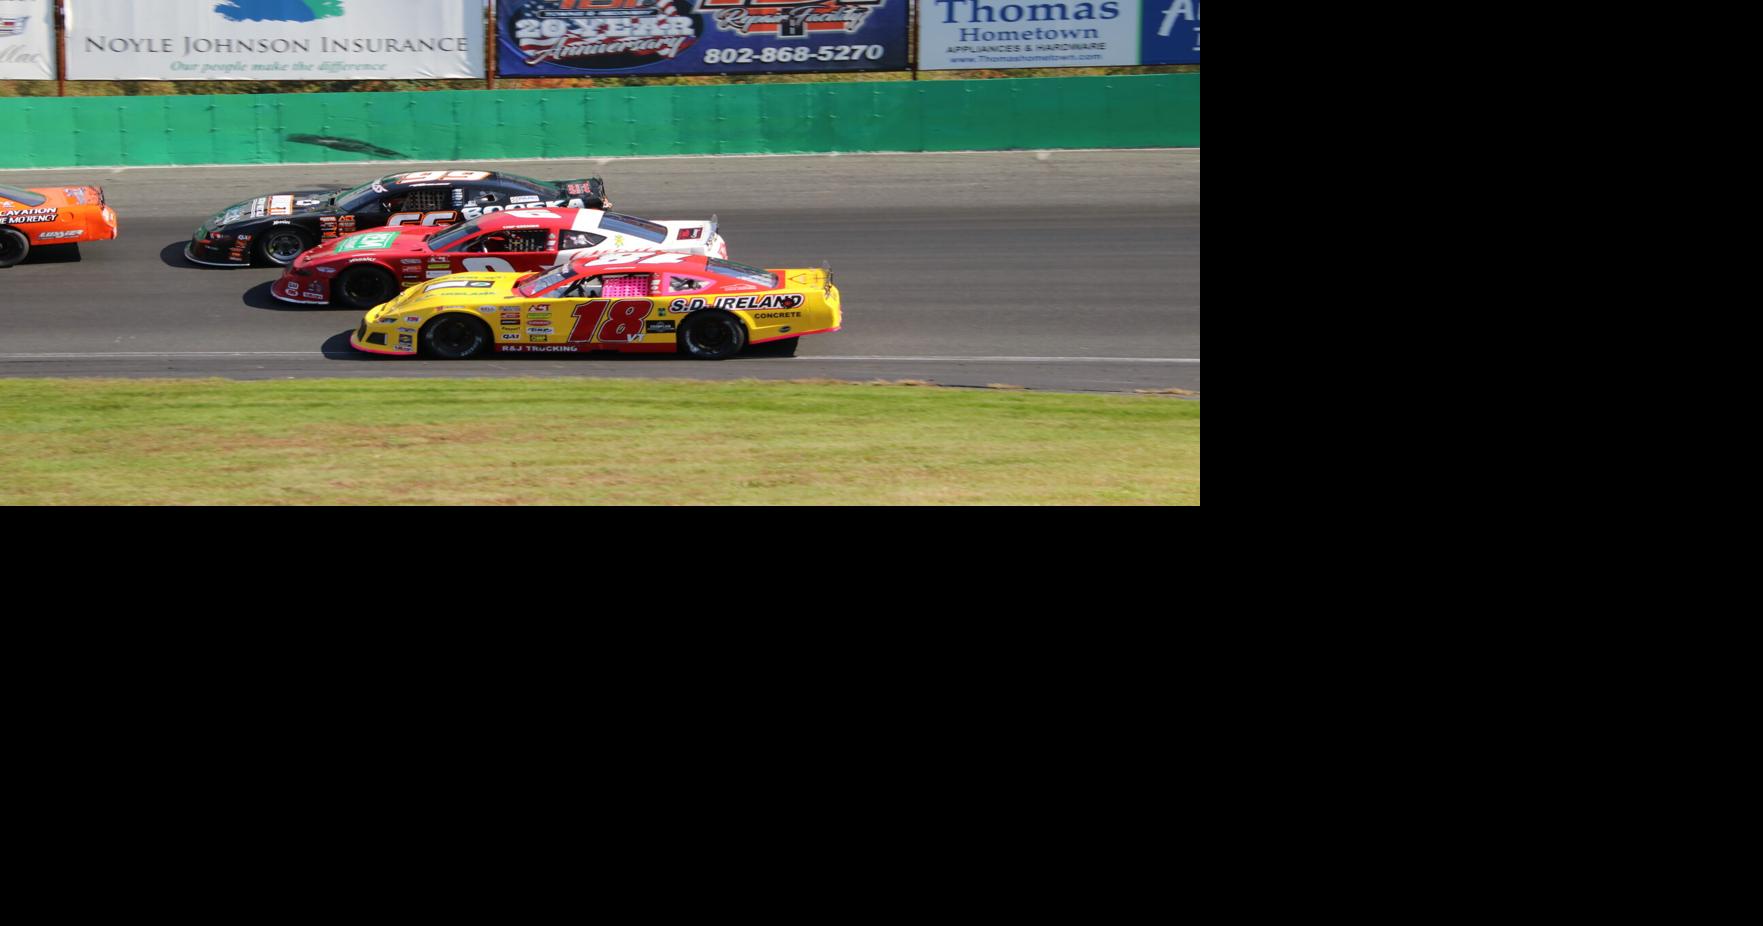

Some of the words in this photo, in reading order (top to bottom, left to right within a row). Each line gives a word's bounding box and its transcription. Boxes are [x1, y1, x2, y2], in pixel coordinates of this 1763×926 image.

[934, 0, 1120, 23] Thomas
[515, 19, 568, 38] 20
[571, 16, 695, 37] YEAR
[958, 27, 1099, 42] Hometown
[84, 36, 173, 53] NOYLE
[183, 36, 310, 55] JOHNSON
[319, 36, 468, 53] INSURANCE
[525, 36, 685, 65] Anniversary
[946, 45, 1020, 53] APPLIANCES
[1036, 42, 1106, 51] HARDWARE
[703, 45, 885, 64] 802-868-5270
[170, 61, 198, 71] Our
[201, 62, 247, 74] people
[251, 61, 288, 71] make
[292, 61, 314, 71] the
[318, 60, 387, 73] difference
[528, 304, 551, 312] ACT
[714, 294, 803, 310] IRELAND
[567, 299, 654, 343] 18
[754, 311, 802, 320] CONCRETE
[626, 333, 646, 343] VT
